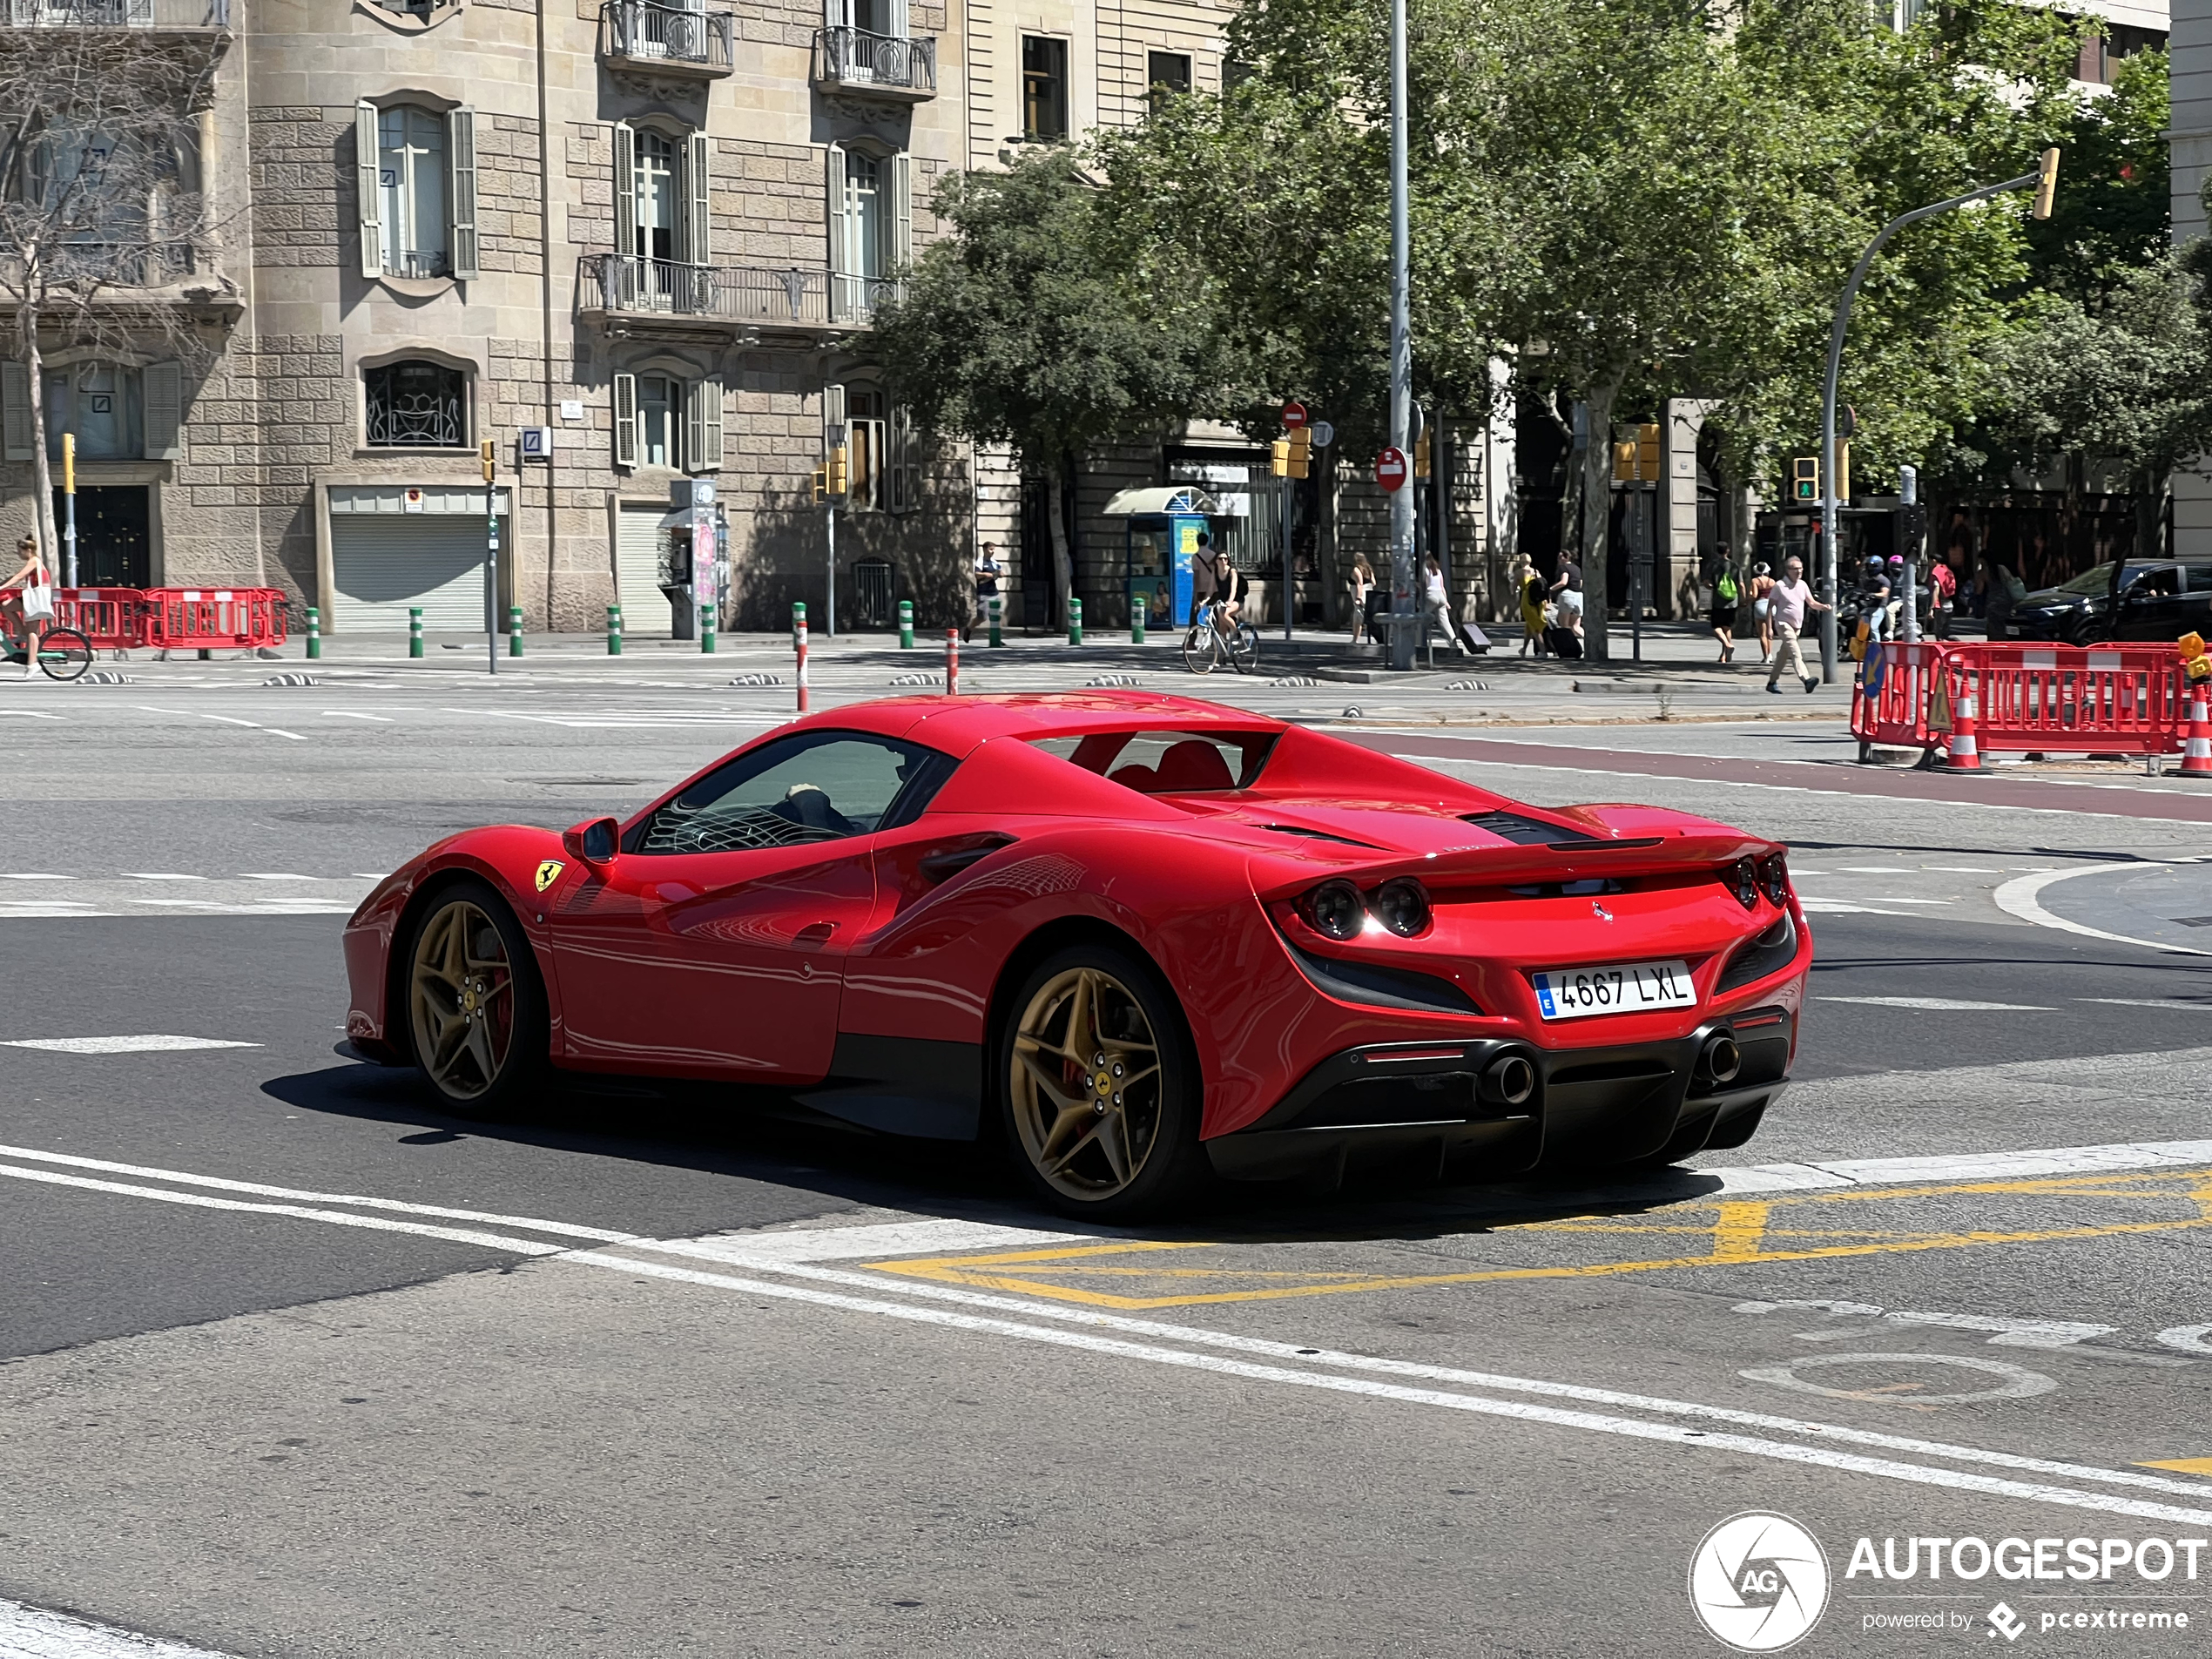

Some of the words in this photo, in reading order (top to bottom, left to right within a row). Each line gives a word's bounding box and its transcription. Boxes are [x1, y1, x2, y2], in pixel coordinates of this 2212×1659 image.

[1561, 971, 1622, 1008] 4667
[1634, 968, 1688, 1001] LXL
[1544, 999, 1552, 1009] E
